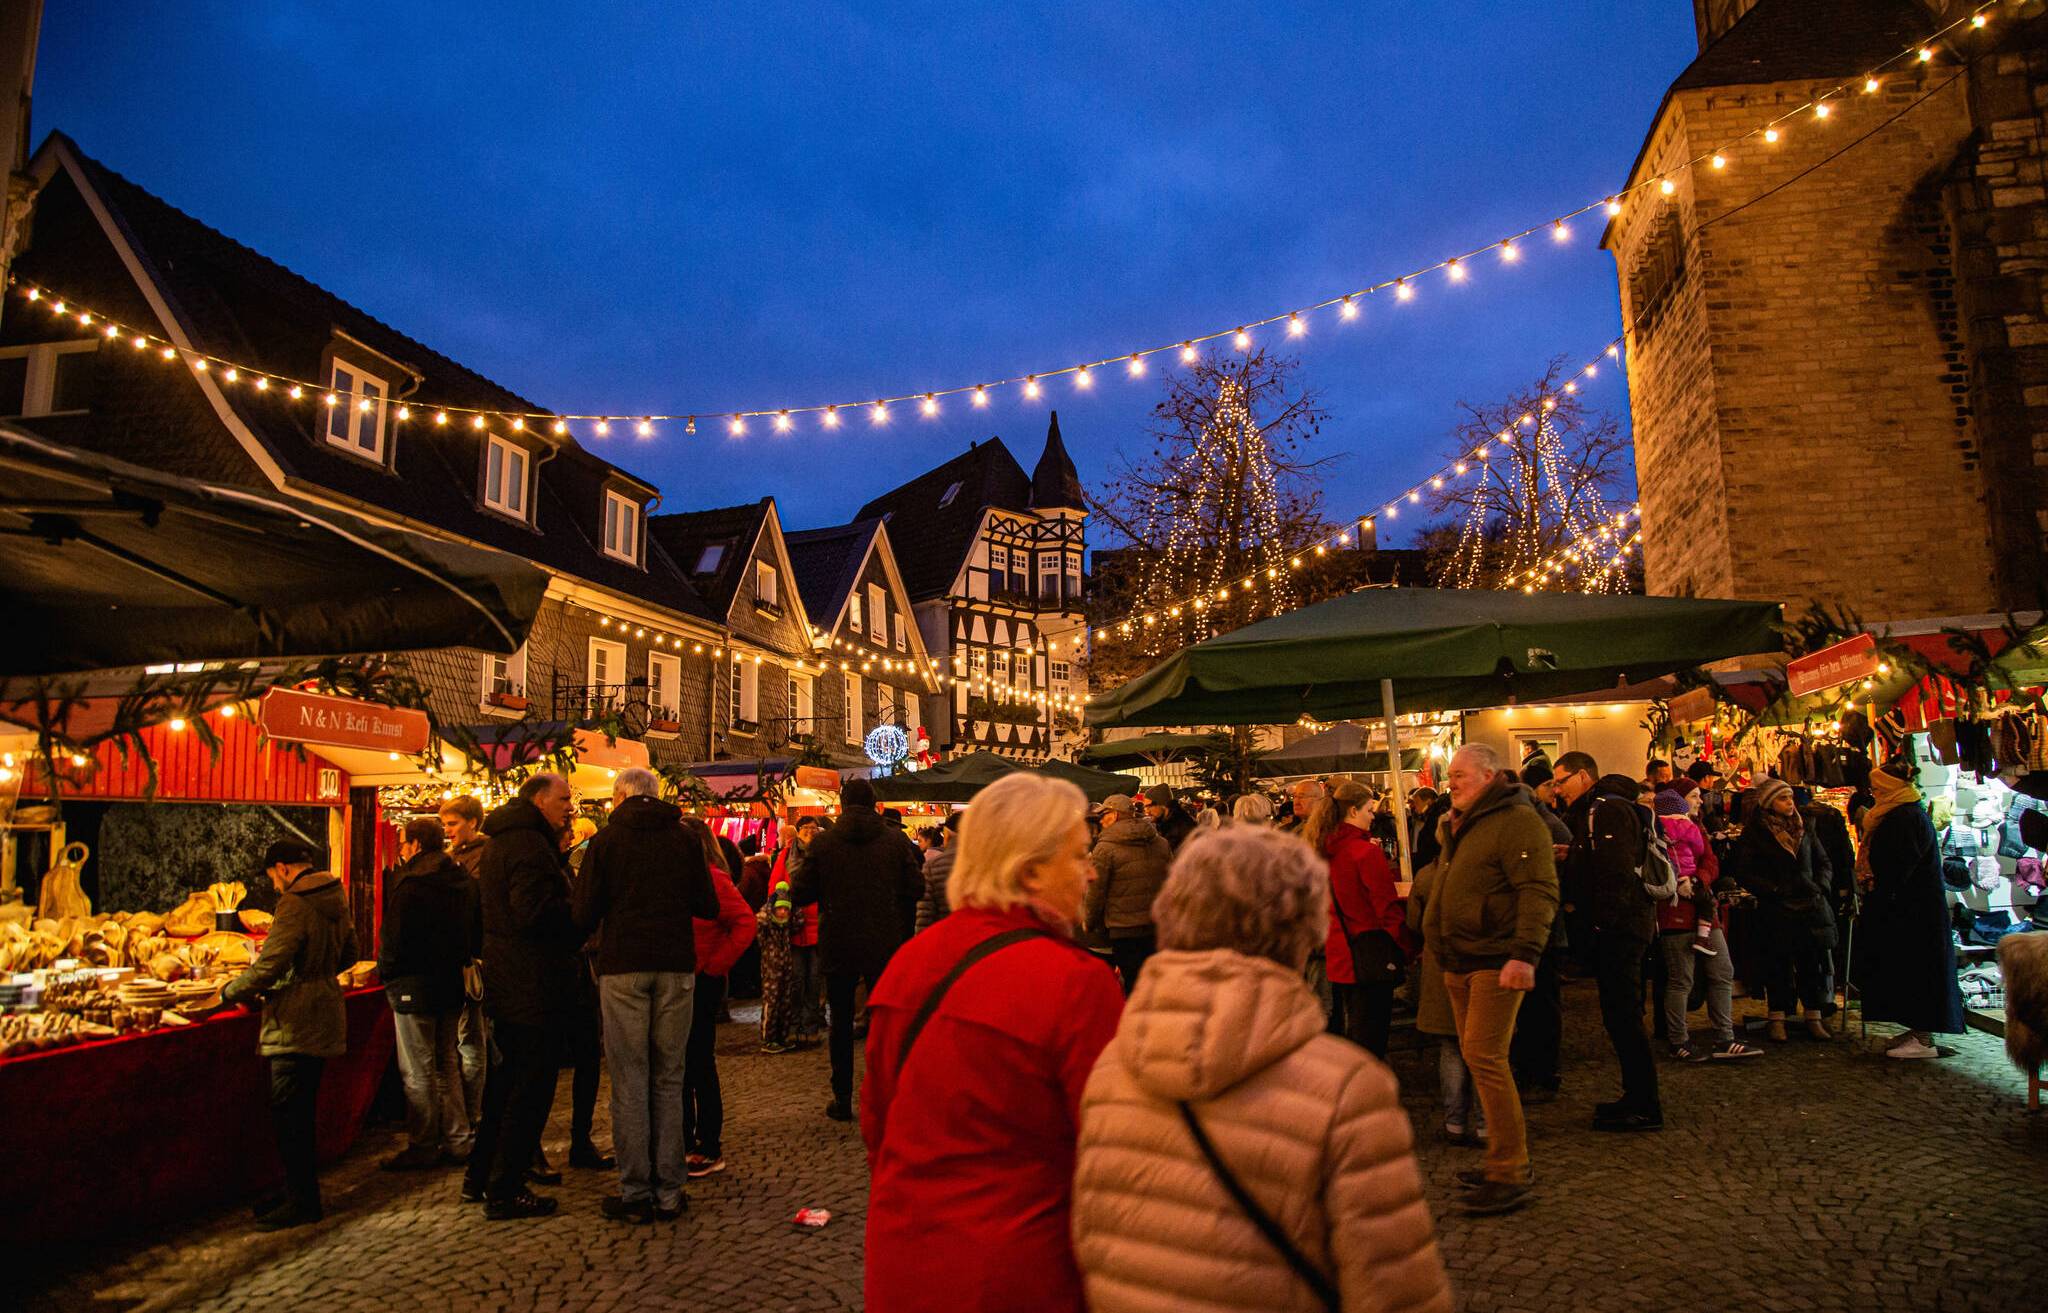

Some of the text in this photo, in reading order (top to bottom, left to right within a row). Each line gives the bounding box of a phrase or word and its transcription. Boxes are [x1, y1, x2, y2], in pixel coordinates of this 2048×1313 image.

[300, 706, 314, 726] N
[315, 709, 327, 728] &
[329, 711, 342, 730] N
[372, 716, 404, 737] Kunst
[322, 770, 337, 793] 10
